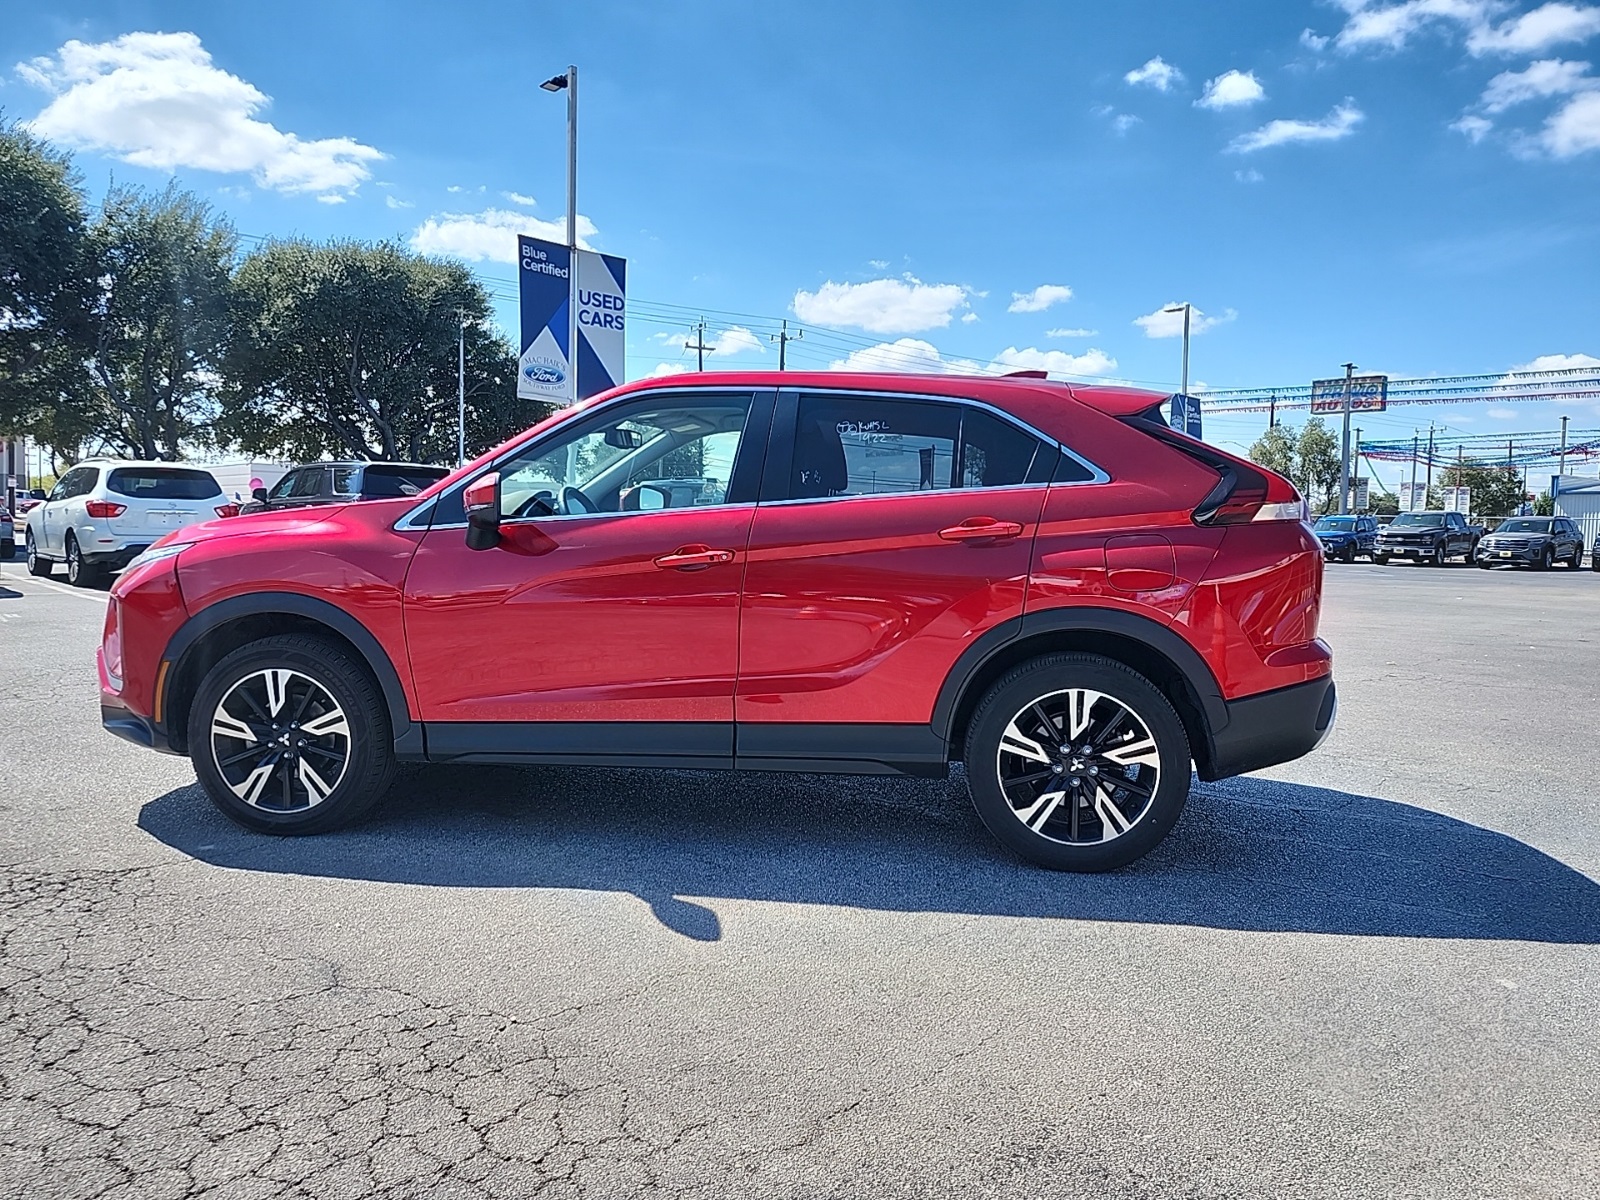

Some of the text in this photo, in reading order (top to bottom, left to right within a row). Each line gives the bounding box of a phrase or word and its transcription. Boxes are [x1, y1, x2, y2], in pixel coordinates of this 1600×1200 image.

[522, 244, 547, 261] Blue
[522, 258, 569, 279] Certified
[578, 289, 625, 311] USED
[578, 309, 625, 331] CARS
[524, 356, 542, 367] MAC
[530, 366, 559, 382] Ford
